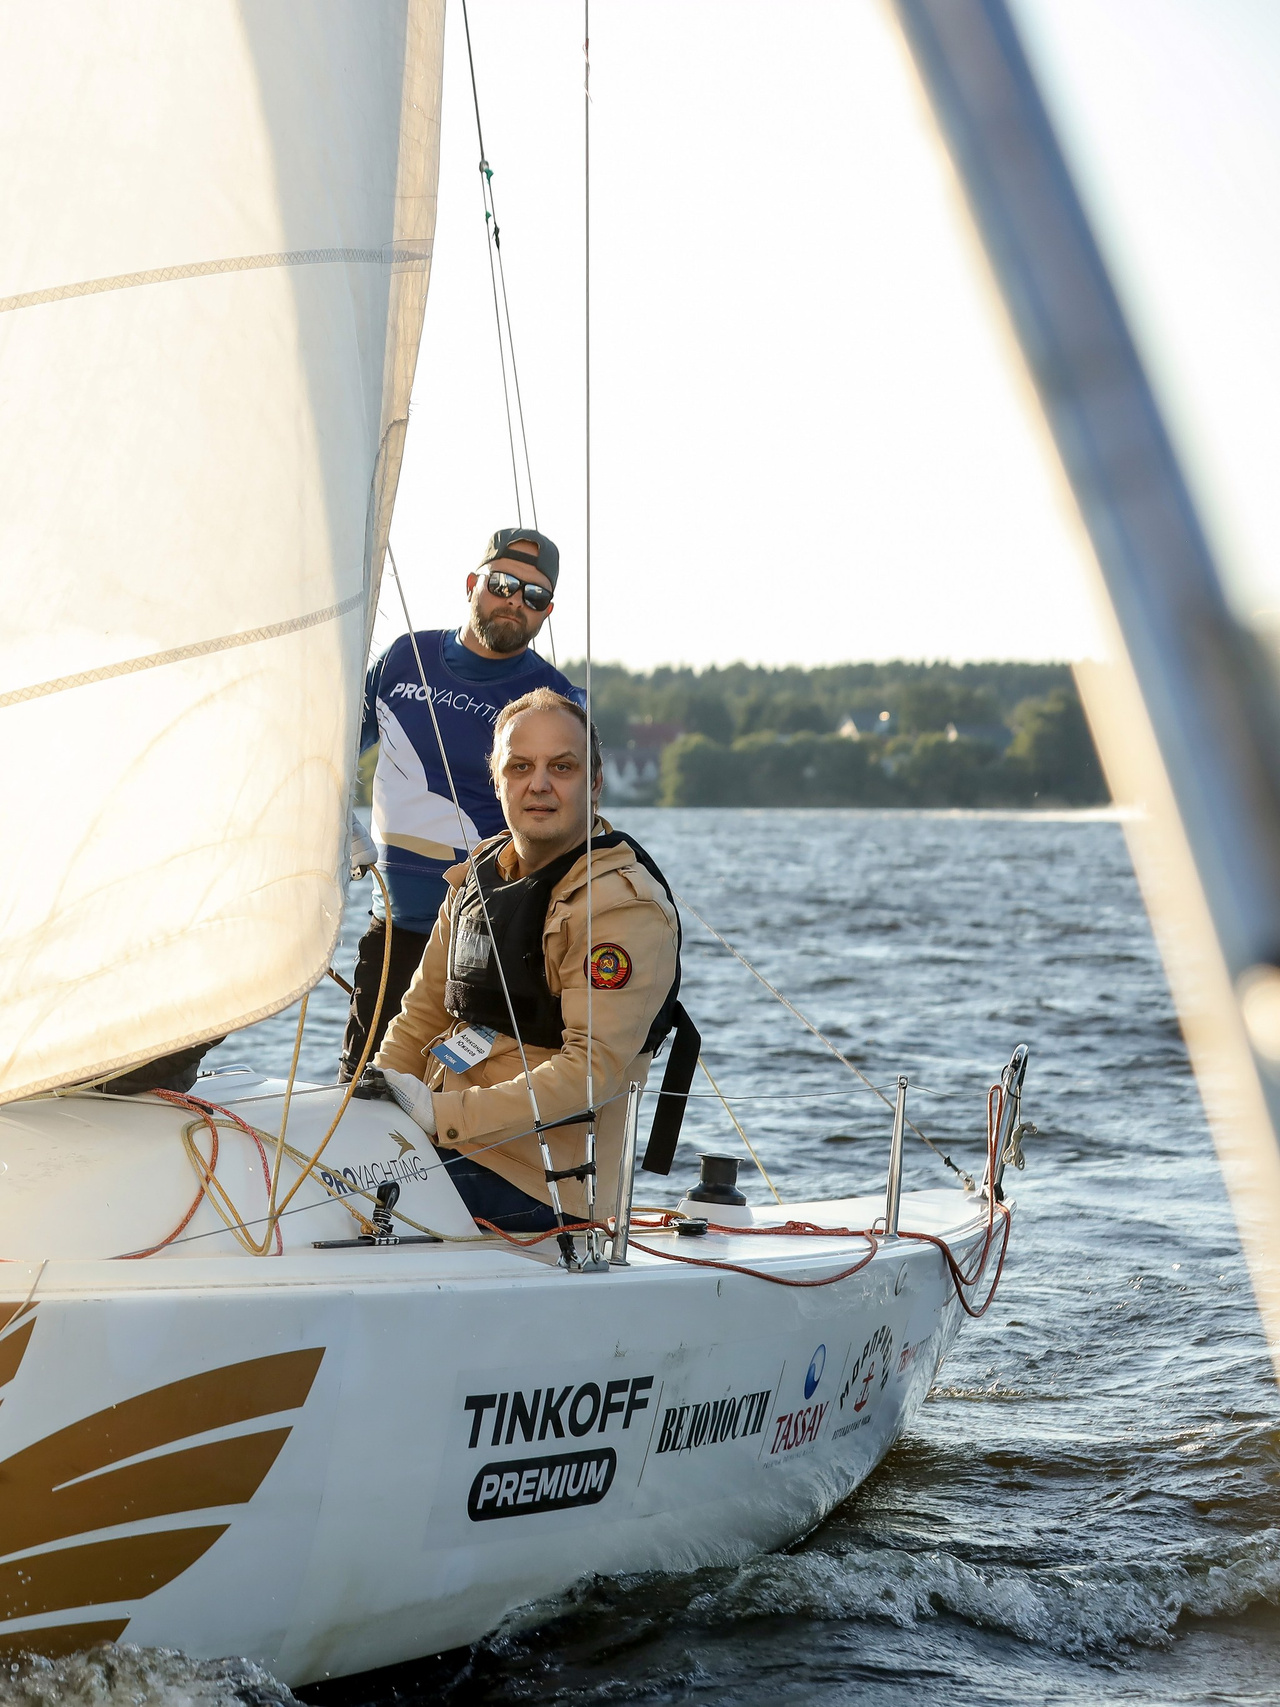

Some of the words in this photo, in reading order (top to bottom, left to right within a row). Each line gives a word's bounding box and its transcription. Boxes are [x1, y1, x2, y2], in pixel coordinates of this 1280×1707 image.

[321, 1156, 428, 1197] PROYACHTING
[464, 1375, 654, 1449] TINKOFF
[655, 1389, 772, 1457] ВЕДОМОСТИ
[770, 1400, 830, 1455] TASSAY
[476, 1458, 610, 1510] PREMIUM
